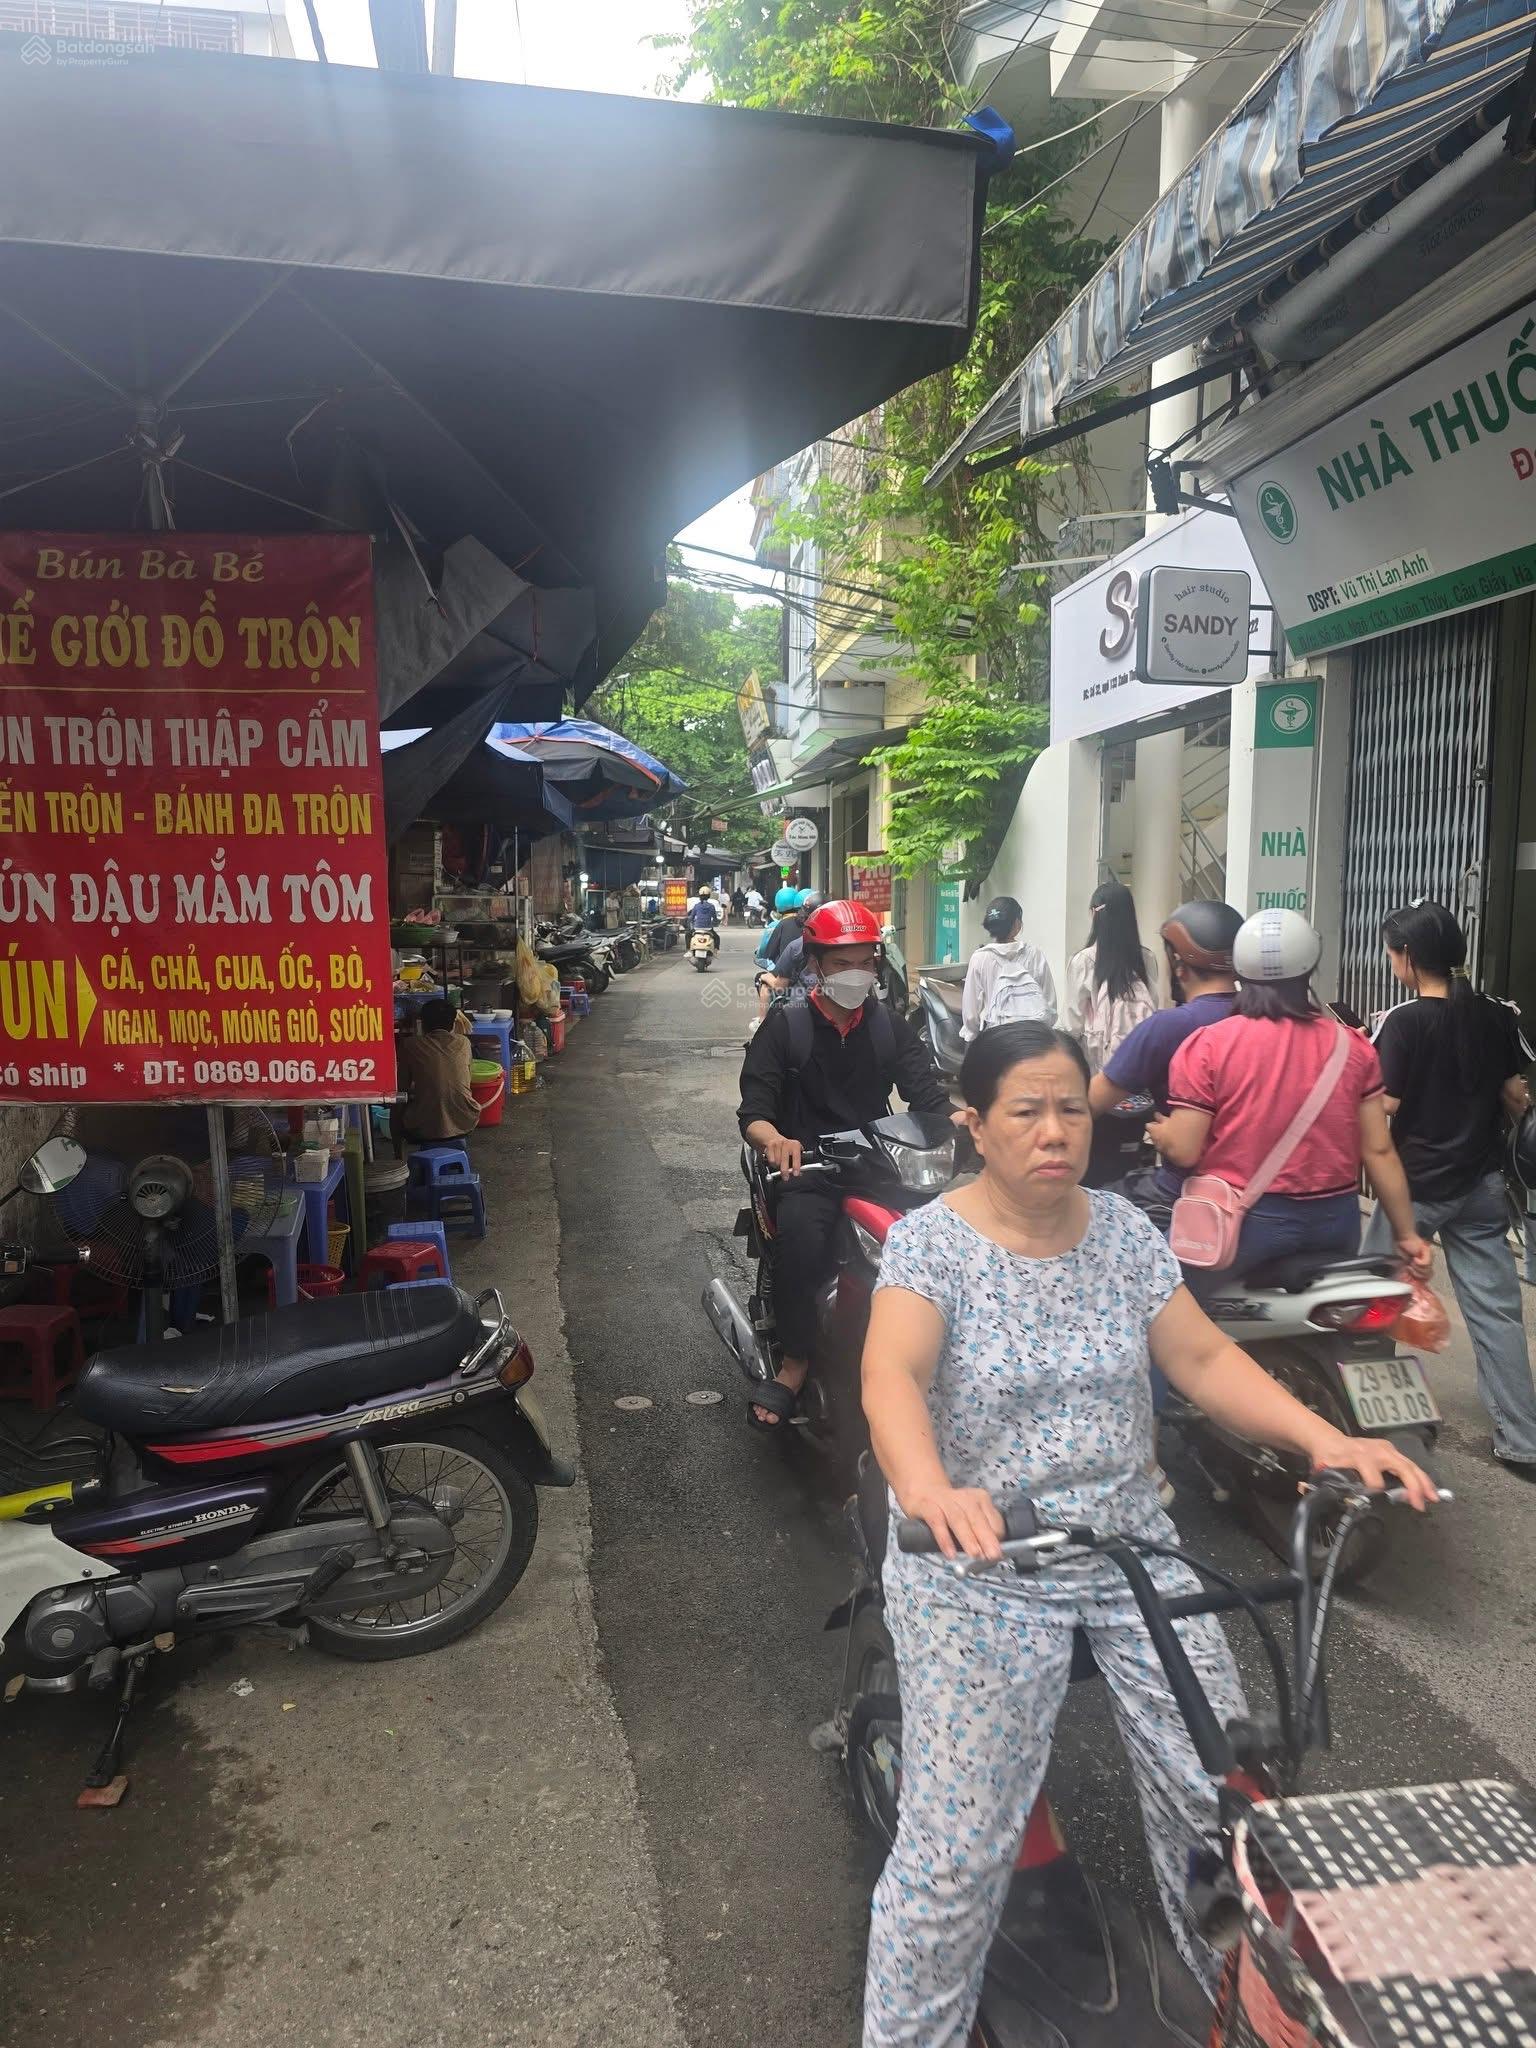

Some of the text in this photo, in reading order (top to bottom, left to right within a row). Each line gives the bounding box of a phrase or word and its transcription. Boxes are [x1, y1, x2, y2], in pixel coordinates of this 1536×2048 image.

[1316, 418, 1414, 511] NHÀ
[36, 549, 265, 583] Bún Bà Bé
[1307, 553, 1429, 613] DSPT: Vũ Thị Lan Anh
[1174, 583, 1231, 604] hair studio
[51, 598, 151, 668] GIỚI
[160, 588, 225, 669] ĐỒ
[237, 600, 362, 684] TRỘN
[1163, 613, 1239, 636] SANDY
[44, 707, 154, 778] TRỘN
[164, 708, 264, 778] THẬP
[278, 698, 368, 768] CẨM
[44, 783, 123, 844] TRỘN
[154, 784, 235, 835] BÁNH
[242, 794, 285, 835] ĐA
[292, 784, 372, 844] TRỘN
[1260, 826, 1307, 857] NHÀ
[70, 858, 161, 937] ĐẬU
[174, 847, 273, 924] MẮM
[282, 858, 374, 923] TÔM
[1256, 887, 1307, 911] THUỐC
[101, 942, 372, 995] CÁ, CHẢ, CUA, ỐC, BÒ,
[103, 1000, 384, 1051] NGAN, MỌC, MÓNG GIÒ, SƯỜN
[28, 1062, 87, 1089] ship
[143, 1060, 185, 1085] ĐT:
[194, 1058, 376, 1084] 0869.066.462
[194, 1503, 251, 1523] HONDA
